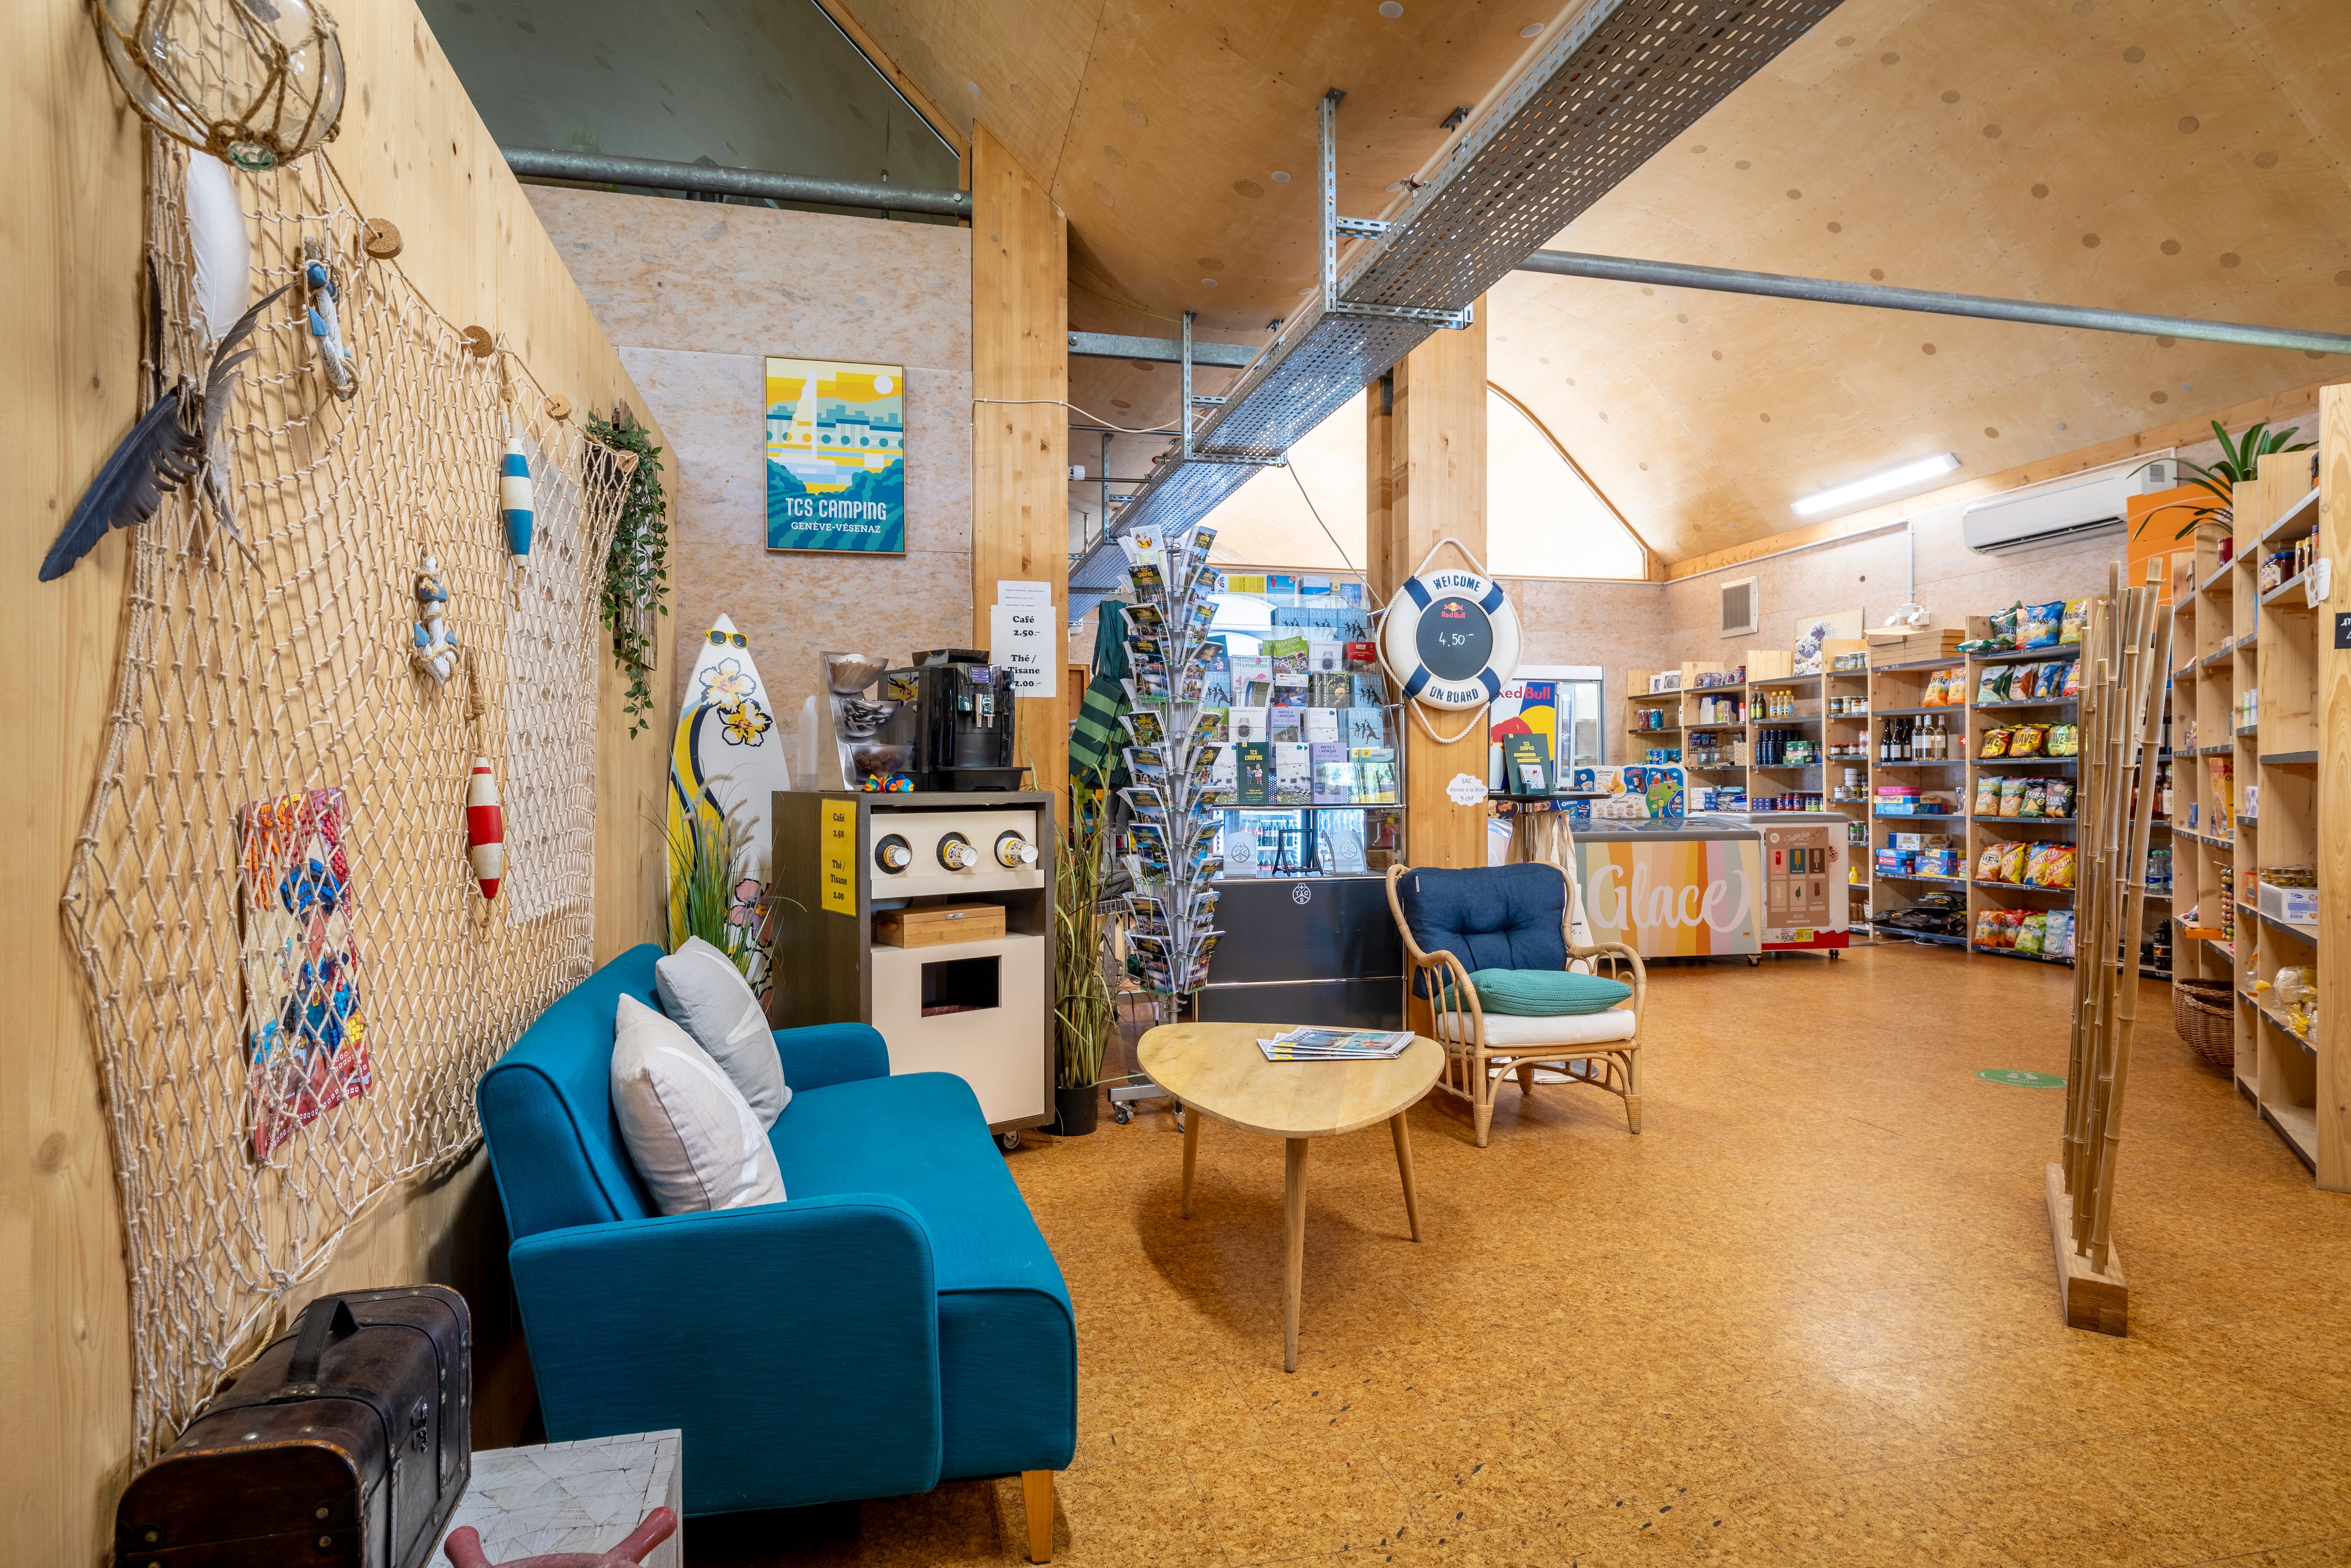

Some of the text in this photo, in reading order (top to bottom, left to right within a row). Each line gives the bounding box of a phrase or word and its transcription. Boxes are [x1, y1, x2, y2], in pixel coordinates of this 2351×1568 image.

[785, 498, 887, 521] TCS CAMPING
[790, 521, 881, 533] GENÈVE-VÉSENAZ
[1433, 575, 1481, 592] WELCOME
[1279, 607, 1305, 618] bains
[1310, 608, 1336, 619] bains
[1340, 608, 1367, 619] bains
[1278, 637, 1299, 647] JARDIN
[1031, 655, 1037, 663] /
[1007, 666, 1040, 674] Tisane
[1355, 674, 1382, 685] bains
[1930, 675, 1948, 685] prika
[1429, 686, 1479, 703] ON BOARD
[1524, 687, 1550, 700] Bull
[1349, 708, 1377, 719] bains
[2026, 790, 2046, 798] CORN
[2046, 794, 2067, 802] CORN
[833, 813, 845, 822] Café
[833, 830, 844, 838] 2.50
[1784, 833, 1802, 845] Paleta
[832, 859, 845, 872] Thé /
[830, 874, 847, 885] Tisane
[833, 891, 844, 900] 2.00
[1587, 862, 1752, 933] Glace
[1977, 919, 1995, 927] aprika
[1781, 934, 1795, 942] PENTANE
